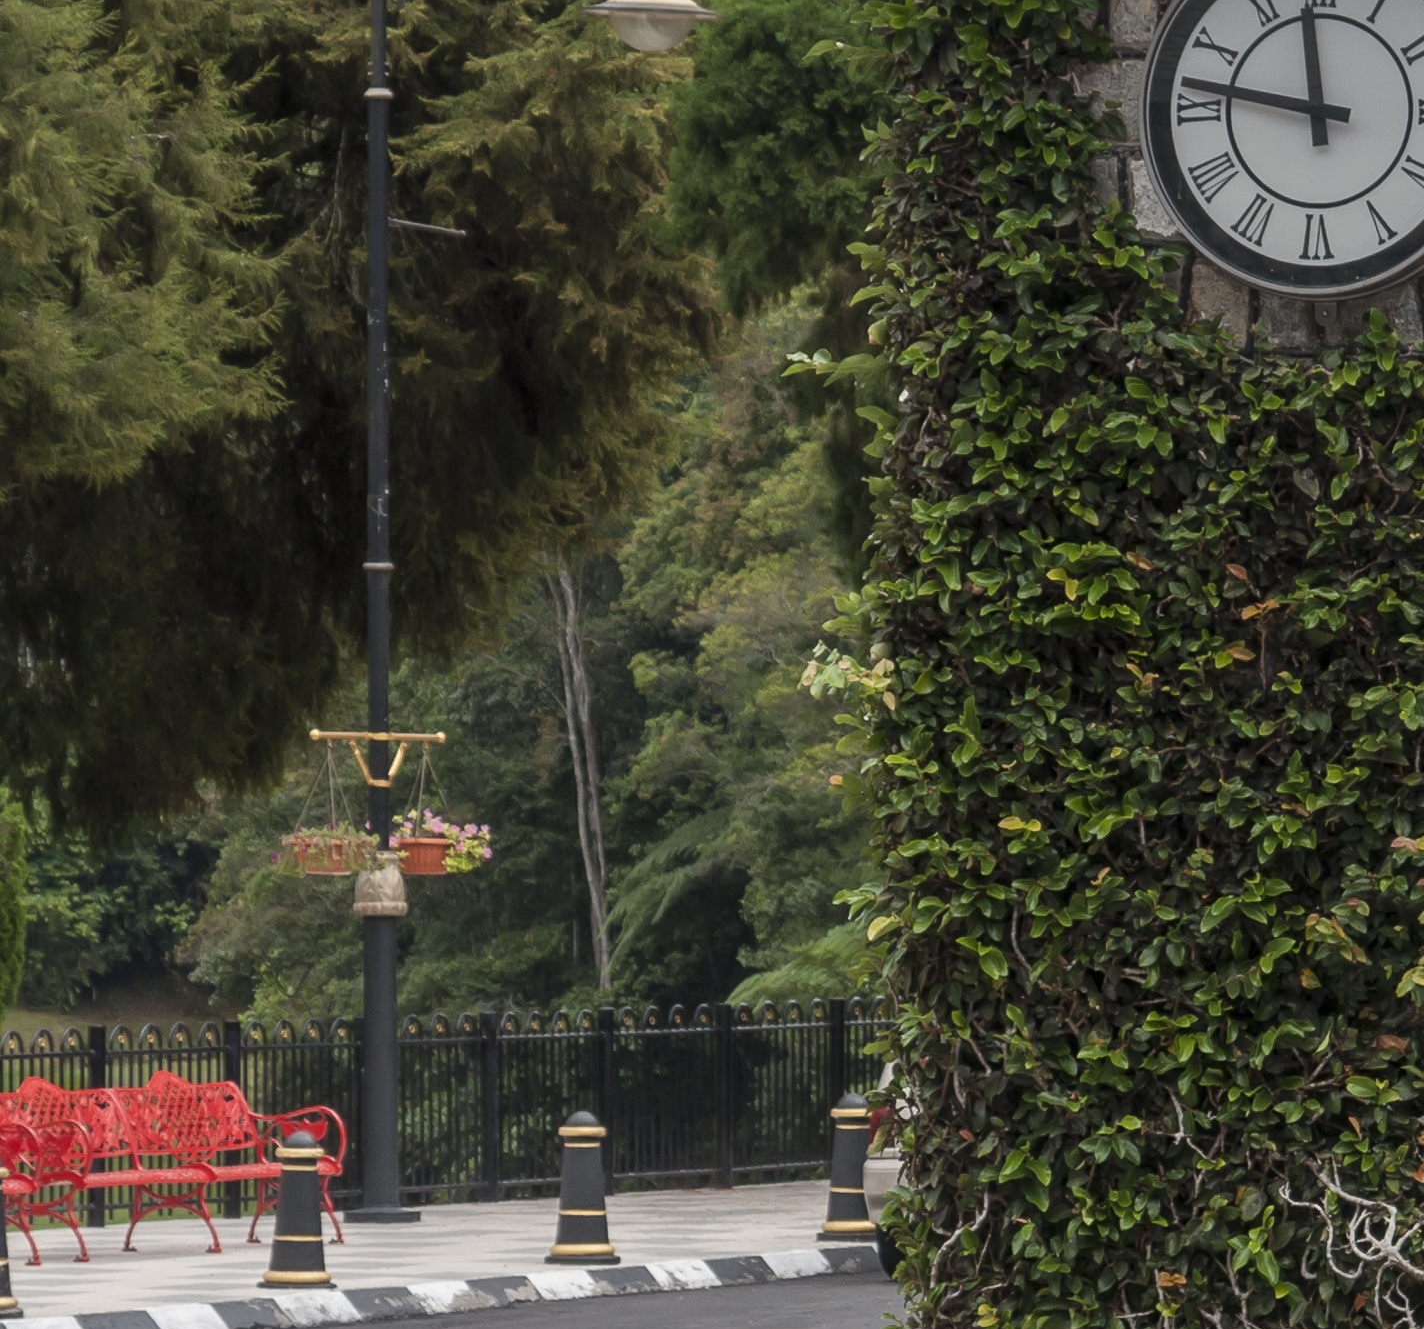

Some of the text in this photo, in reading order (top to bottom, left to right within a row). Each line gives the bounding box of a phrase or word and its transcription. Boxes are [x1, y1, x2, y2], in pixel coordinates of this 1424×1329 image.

[1192, 26, 1238, 66] X
[1177, 92, 1222, 126] IX
[1188, 152, 1239, 204] VIII
[1230, 193, 1274, 247] VII
[1299, 214, 1334, 260] VI
[1366, 200, 1398, 245] V
